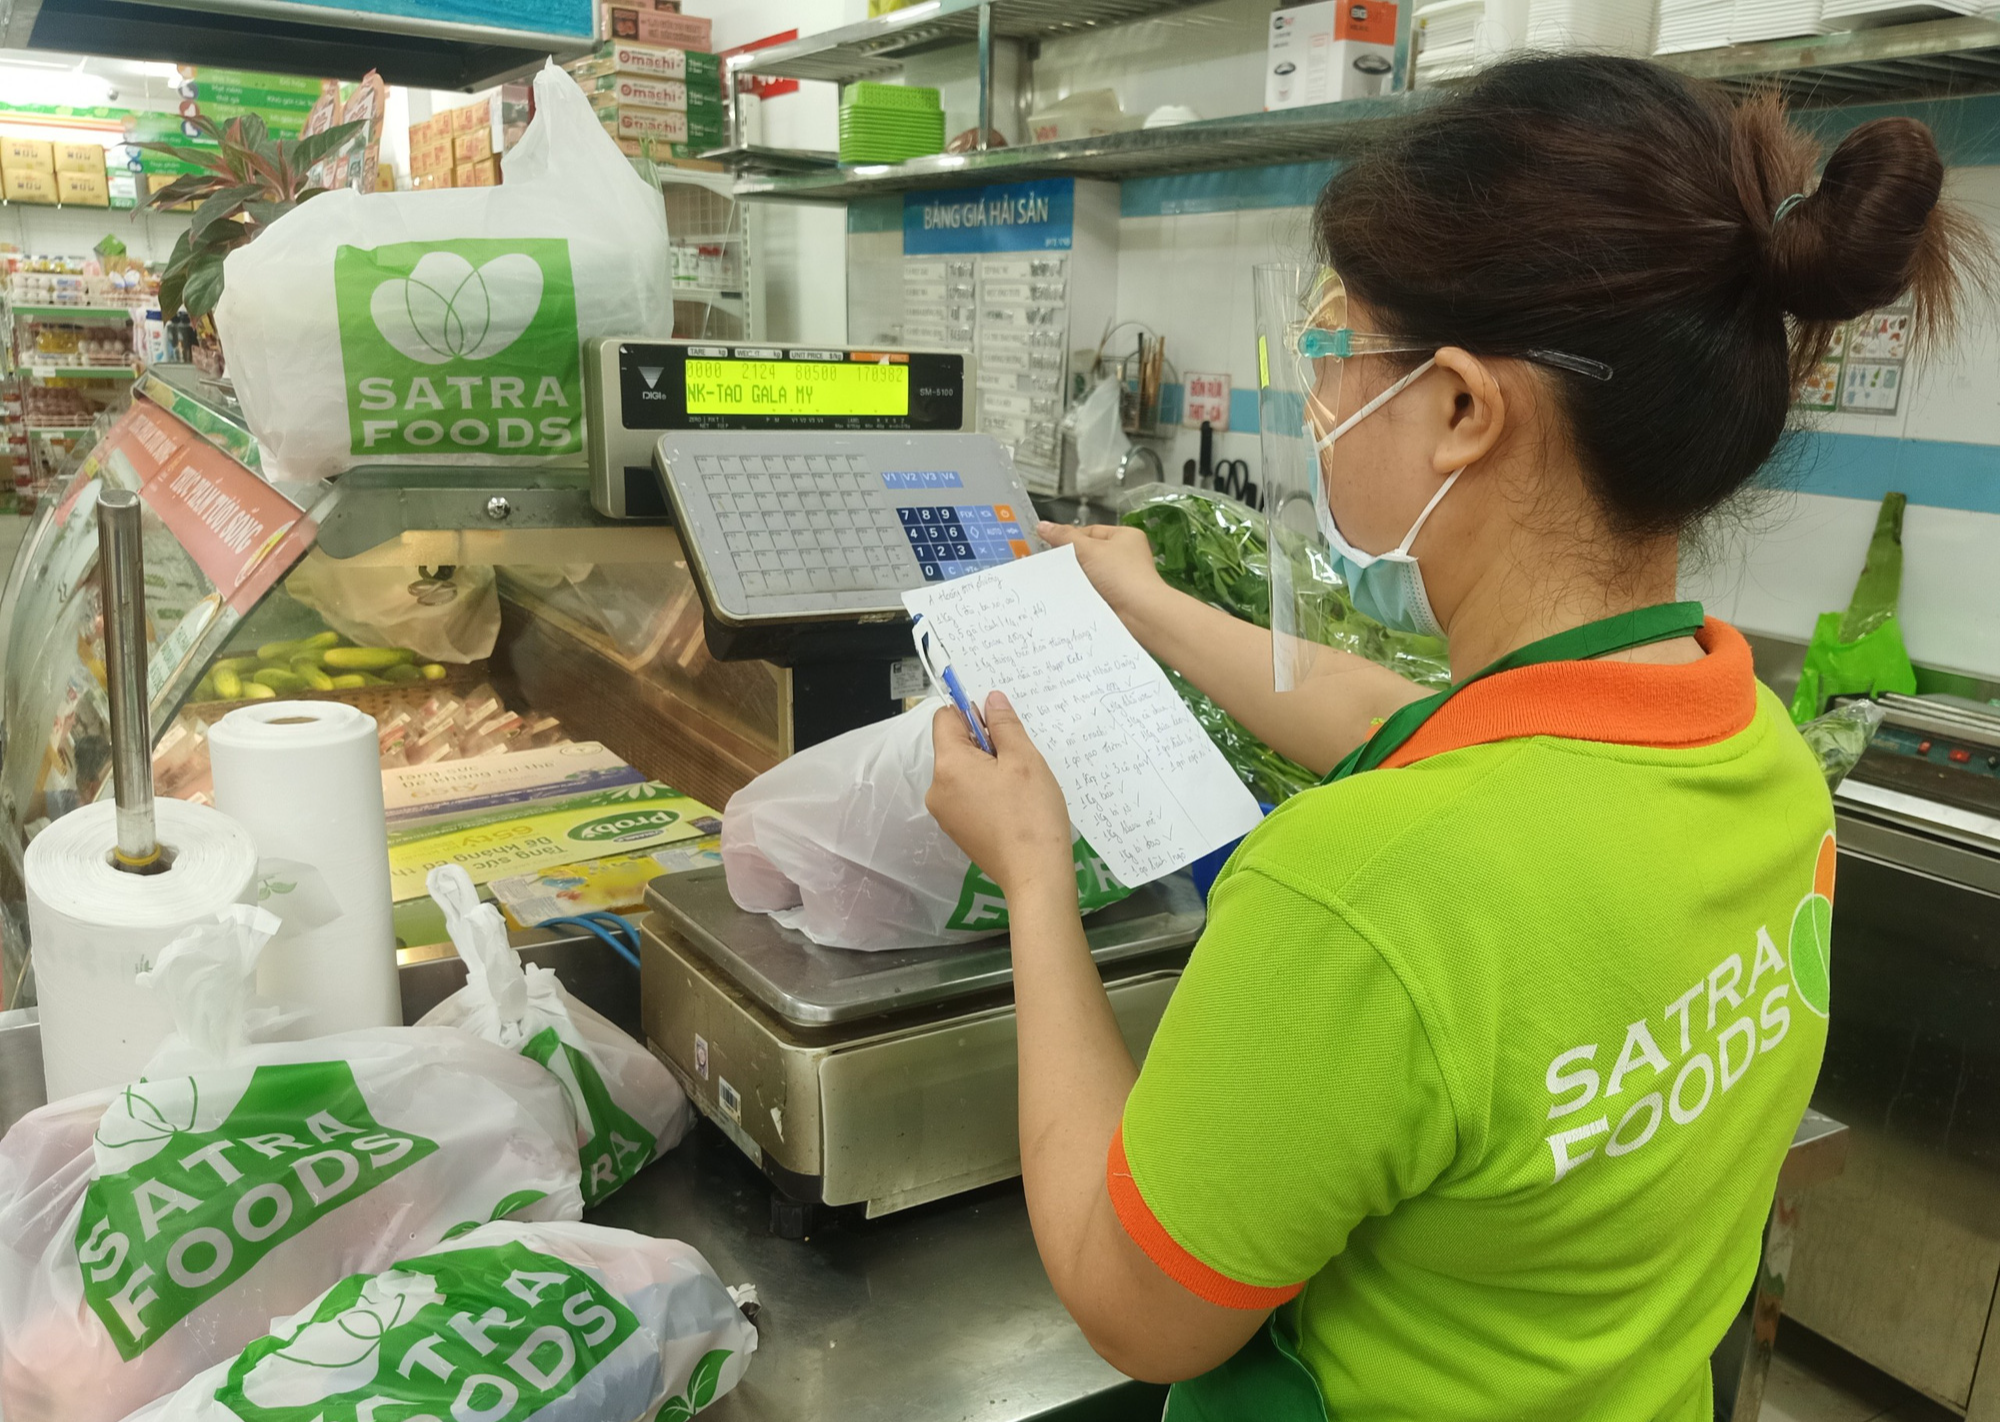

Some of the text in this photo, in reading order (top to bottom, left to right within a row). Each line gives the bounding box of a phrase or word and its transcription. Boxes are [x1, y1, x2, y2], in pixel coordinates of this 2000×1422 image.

[924, 191, 1049, 230] BẢNG GIÁ HẢI SẢN
[792, 352, 806, 360] UNIT
[358, 376, 570, 411] SATRA
[687, 383, 814, 405] NK-TAO GALA MY
[919, 388, 954, 397] SM-5100
[361, 417, 572, 449] FOODS
[882, 471, 956, 482] V1 V2 V3 V4
[901, 509, 975, 520] 7 8 9 FIX
[910, 528, 918, 539] 4
[929, 528, 938, 538] 5
[949, 527, 958, 537] 6
[917, 545, 966, 557] 1 2 3
[925, 566, 956, 576] 0 C
[453, 842, 521, 862] kháng
[473, 846, 568, 870] Tăng sức
[1545, 924, 1786, 1121] SATRA
[1545, 983, 1791, 1186] FOODS
[79, 1109, 368, 1284] SATRA
[105, 1132, 415, 1342] FOODS
[395, 1269, 572, 1385] TRA
